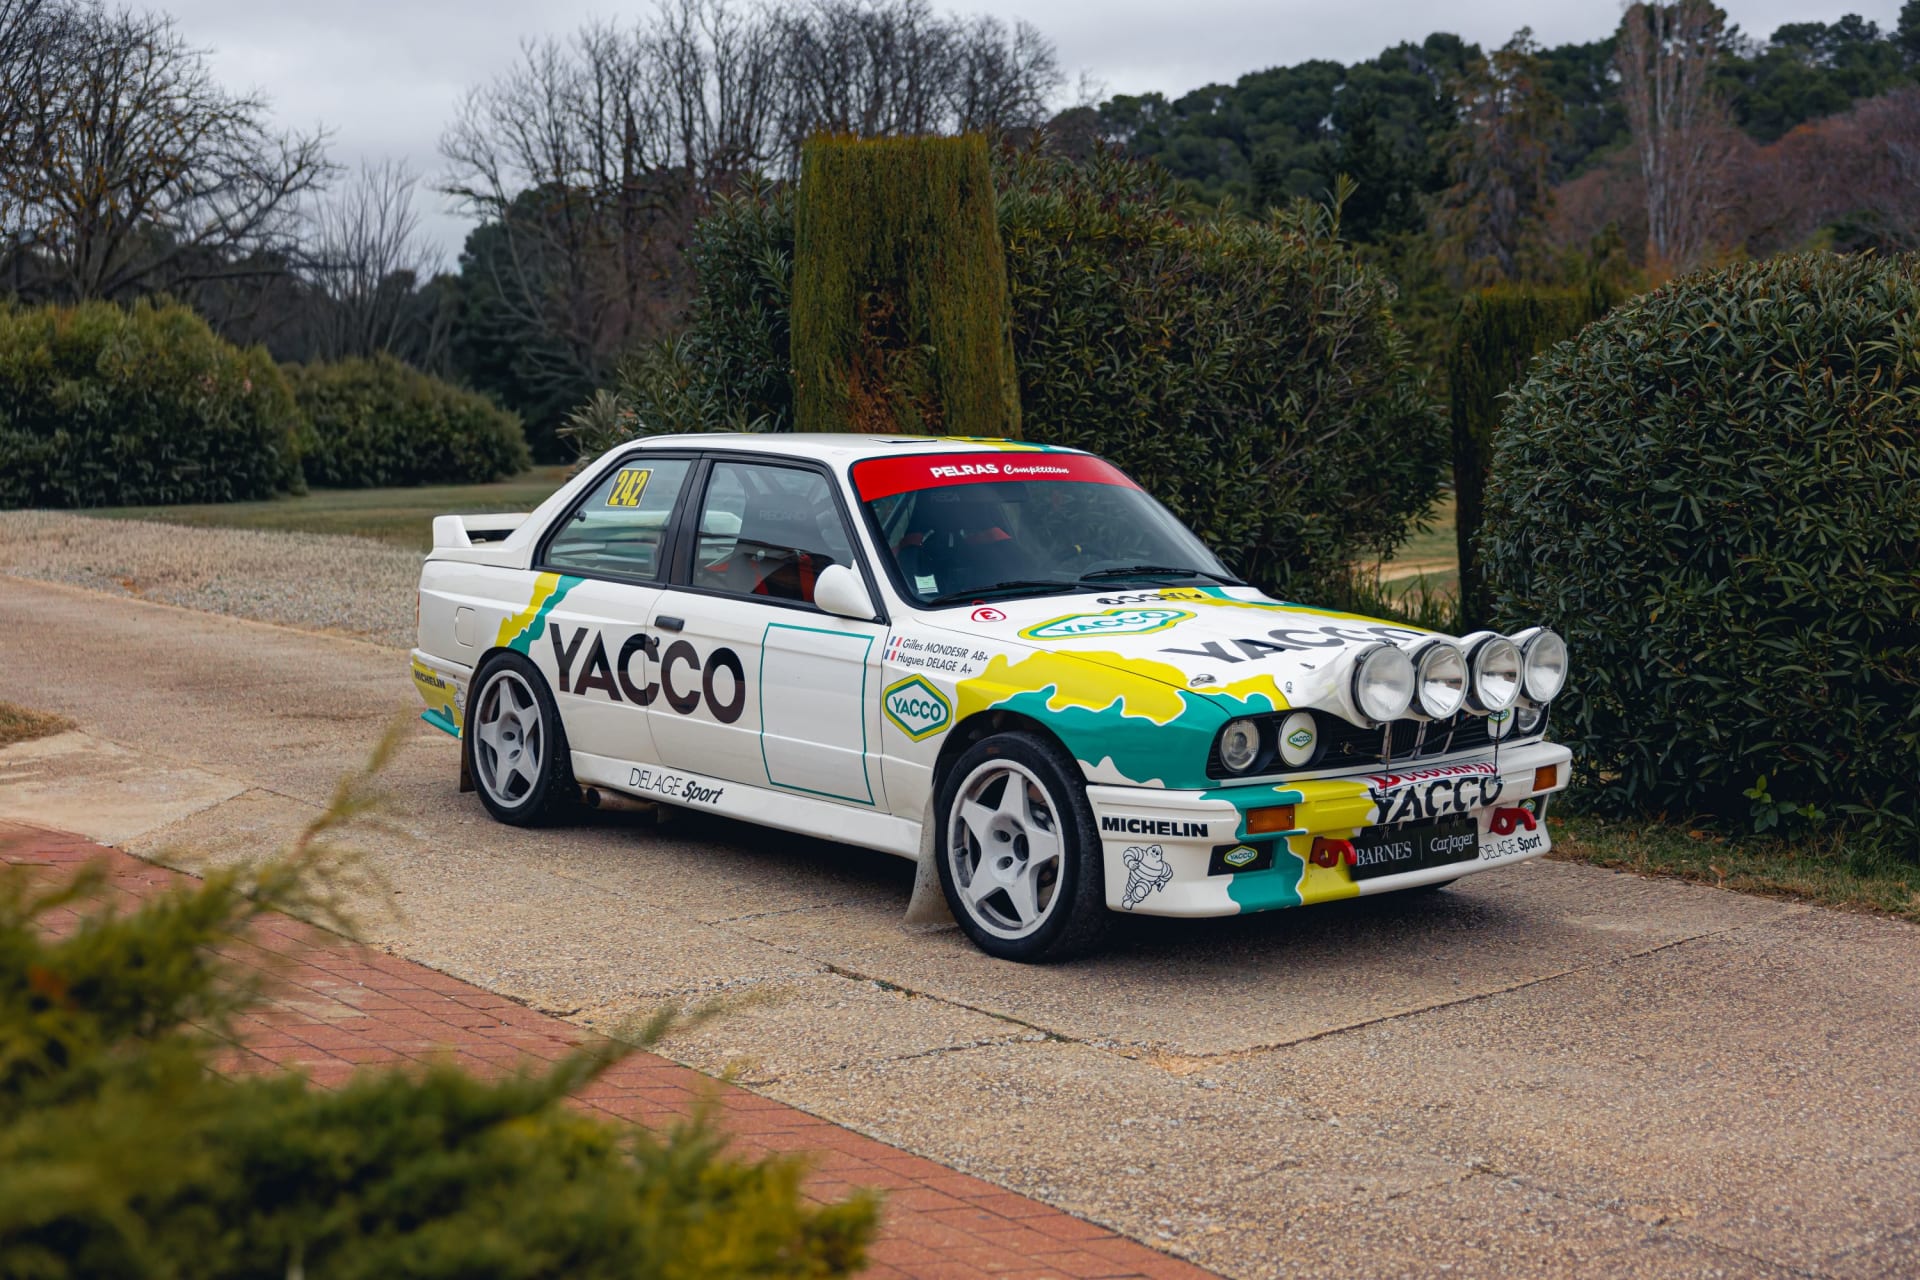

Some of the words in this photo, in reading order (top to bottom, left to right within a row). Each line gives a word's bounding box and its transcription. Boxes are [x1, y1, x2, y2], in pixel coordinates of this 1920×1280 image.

[930, 464, 998, 478] PELRAS
[609, 470, 648, 506] 242
[1048, 611, 1170, 634] YACCO
[902, 638, 923, 652] Gilles
[924, 642, 969, 659] MONDESIR
[971, 650, 989, 662] AB+
[549, 622, 746, 724] YACCO
[896, 651, 925, 667] Hugues
[926, 656, 958, 672] DELAGE
[960, 663, 973, 674] A+
[414, 669, 446, 689] MICHELIN
[892, 696, 942, 721] YACCO
[628, 767, 683, 796] DELAGE
[681, 780, 724, 804] Sport
[1367, 776, 1503, 826] YACCO
[1101, 816, 1209, 838] MICHELIN
[1229, 851, 1254, 860] YACCO
[1356, 840, 1412, 867] BARNES
[1430, 833, 1475, 855] CarJager
[1478, 838, 1519, 861] DELAGE
[1517, 833, 1542, 854] Sport
